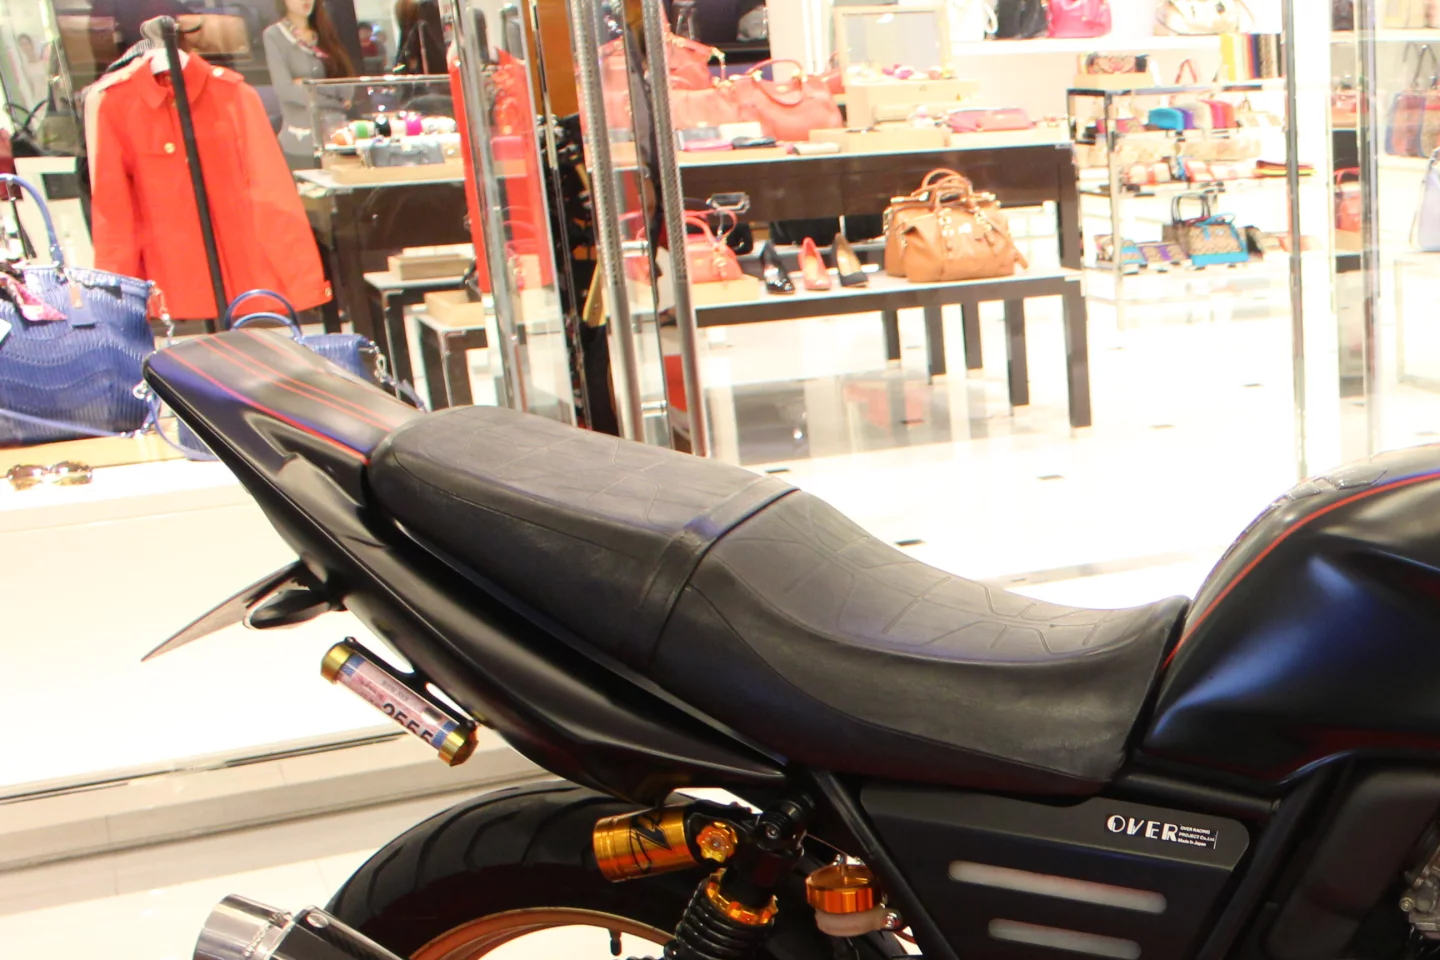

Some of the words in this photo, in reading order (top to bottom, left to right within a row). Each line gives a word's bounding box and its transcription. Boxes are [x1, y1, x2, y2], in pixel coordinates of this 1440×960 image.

[1107, 815, 1178, 842] OVER
[1194, 827, 1211, 835] RACING
[1178, 832, 1199, 840] PROJECT
